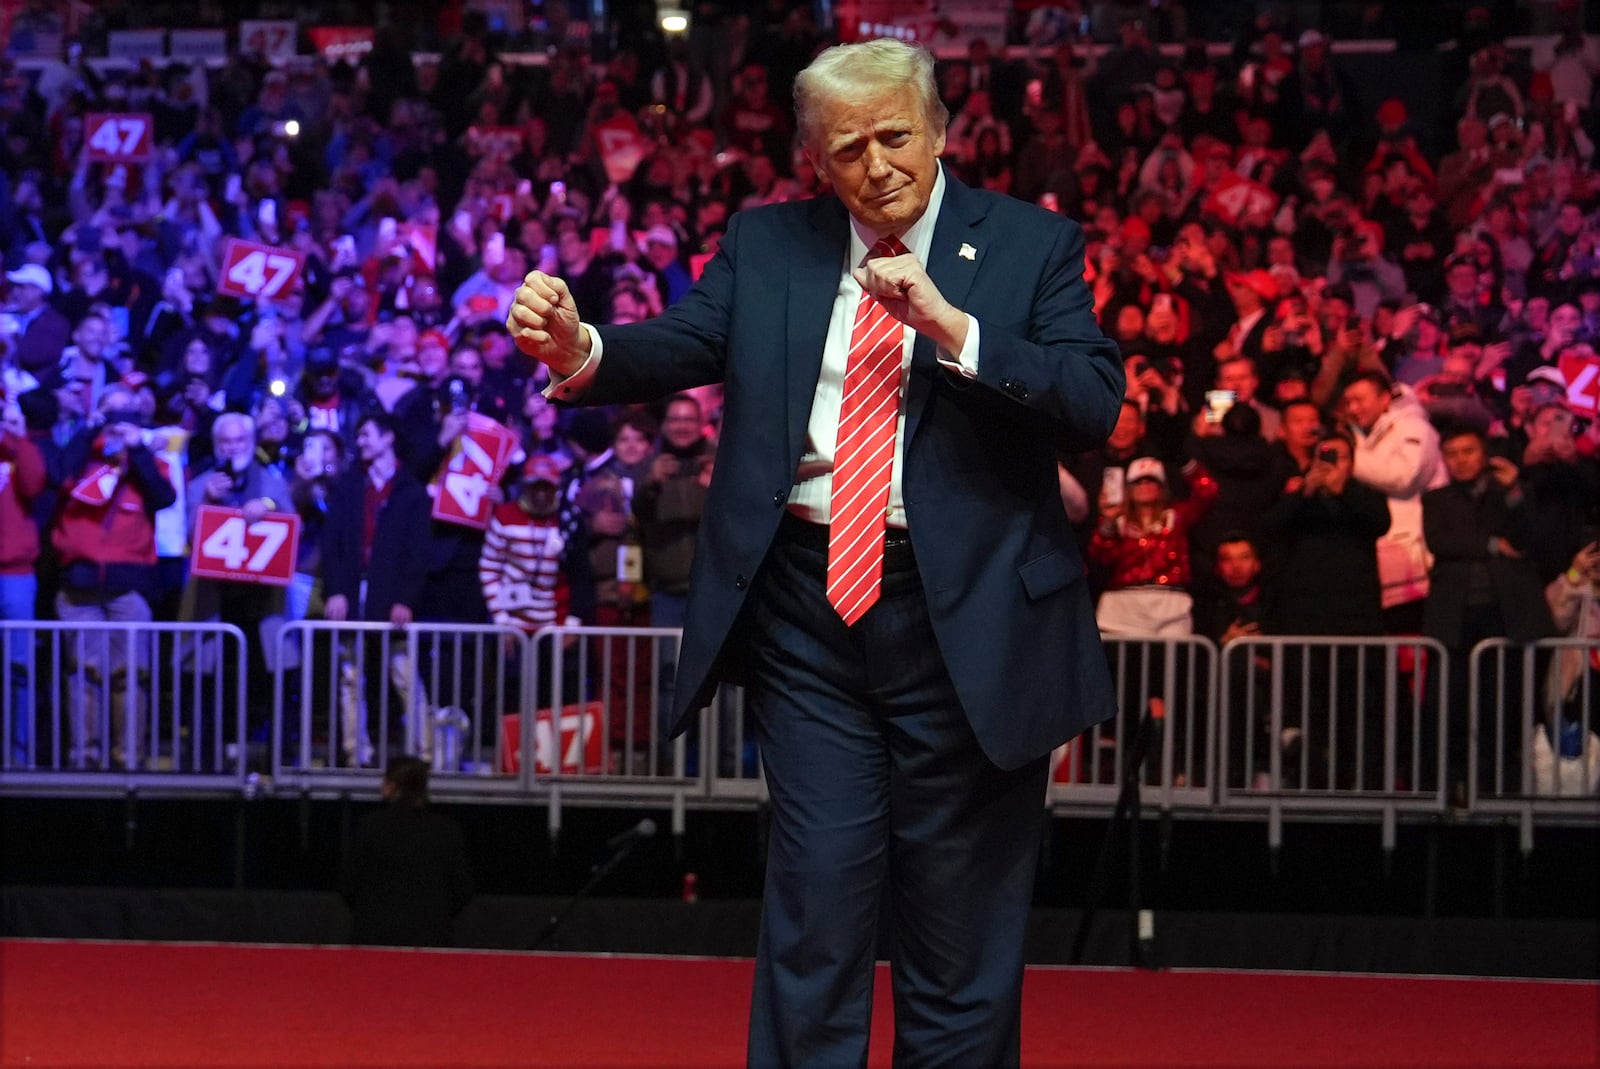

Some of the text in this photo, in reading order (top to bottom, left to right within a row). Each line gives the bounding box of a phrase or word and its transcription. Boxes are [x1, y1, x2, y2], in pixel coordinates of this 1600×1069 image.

[90, 118, 147, 155] 47
[229, 250, 297, 298] 47
[444, 433, 495, 518] 47
[202, 516, 290, 573] 47
